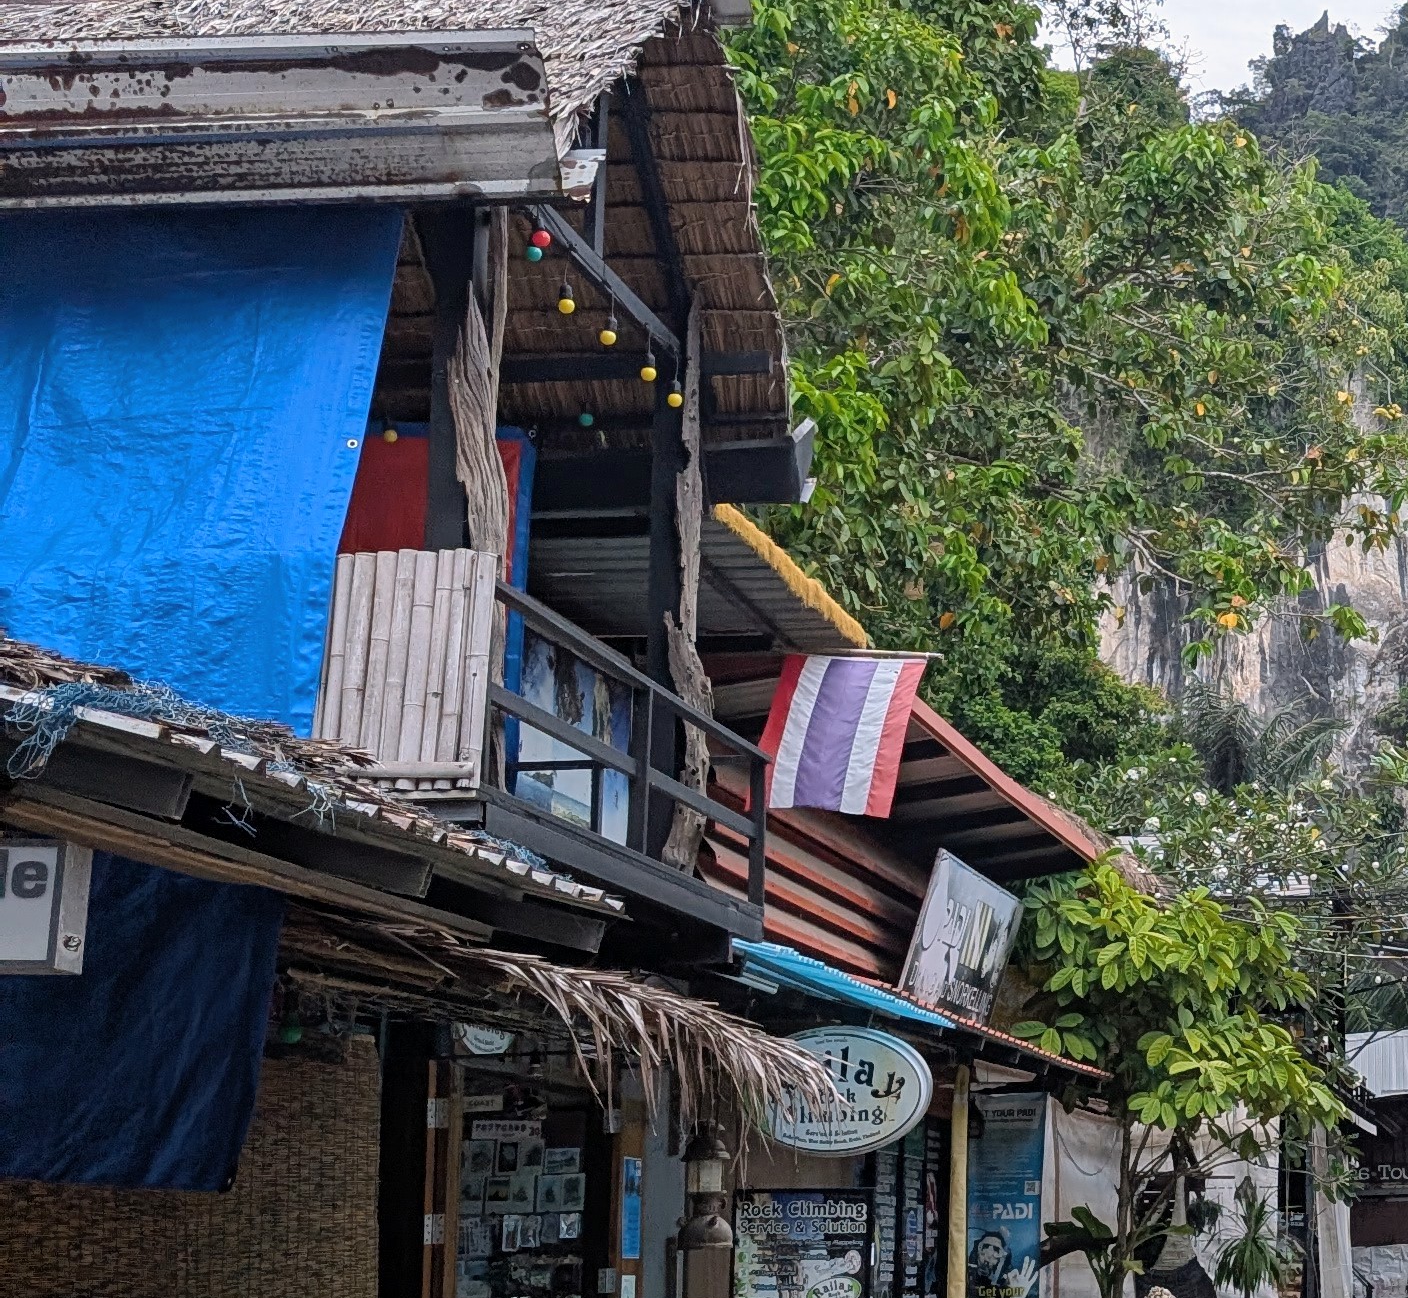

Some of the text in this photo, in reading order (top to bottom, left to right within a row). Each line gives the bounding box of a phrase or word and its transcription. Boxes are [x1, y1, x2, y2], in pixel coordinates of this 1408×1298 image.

[740, 1200, 868, 1221] Rock Climbing
[992, 1203, 1033, 1220] PADI
[740, 1219, 867, 1234] Service & Solution
[813, 1280, 854, 1298] Railay
[978, 1286, 1024, 1298] Get your
